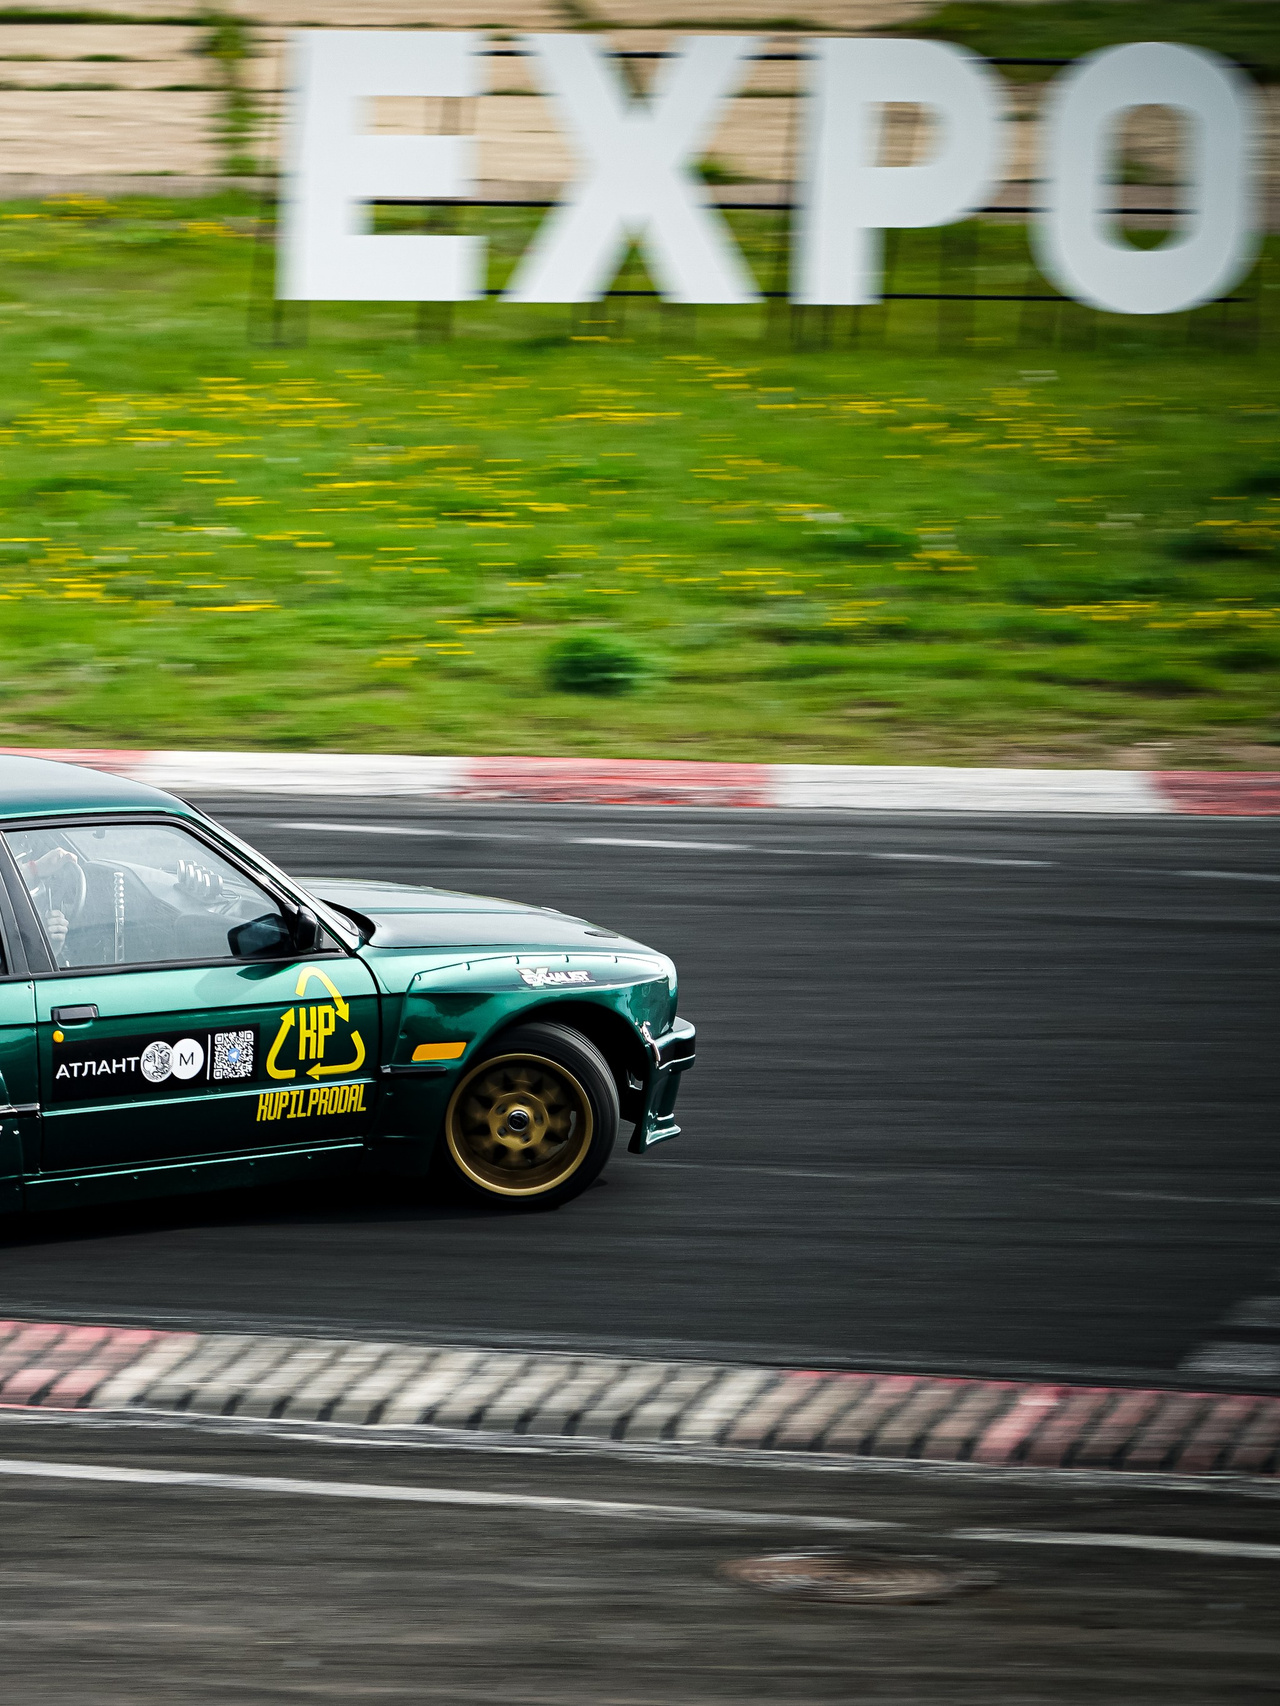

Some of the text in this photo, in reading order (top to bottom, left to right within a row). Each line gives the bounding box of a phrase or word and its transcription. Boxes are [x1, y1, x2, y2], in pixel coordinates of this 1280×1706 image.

[277, 31, 1258, 315] EXPO
[55, 1056, 140, 1080] АТЛАНТ
[256, 1084, 367, 1121] KUPILPRODAL
